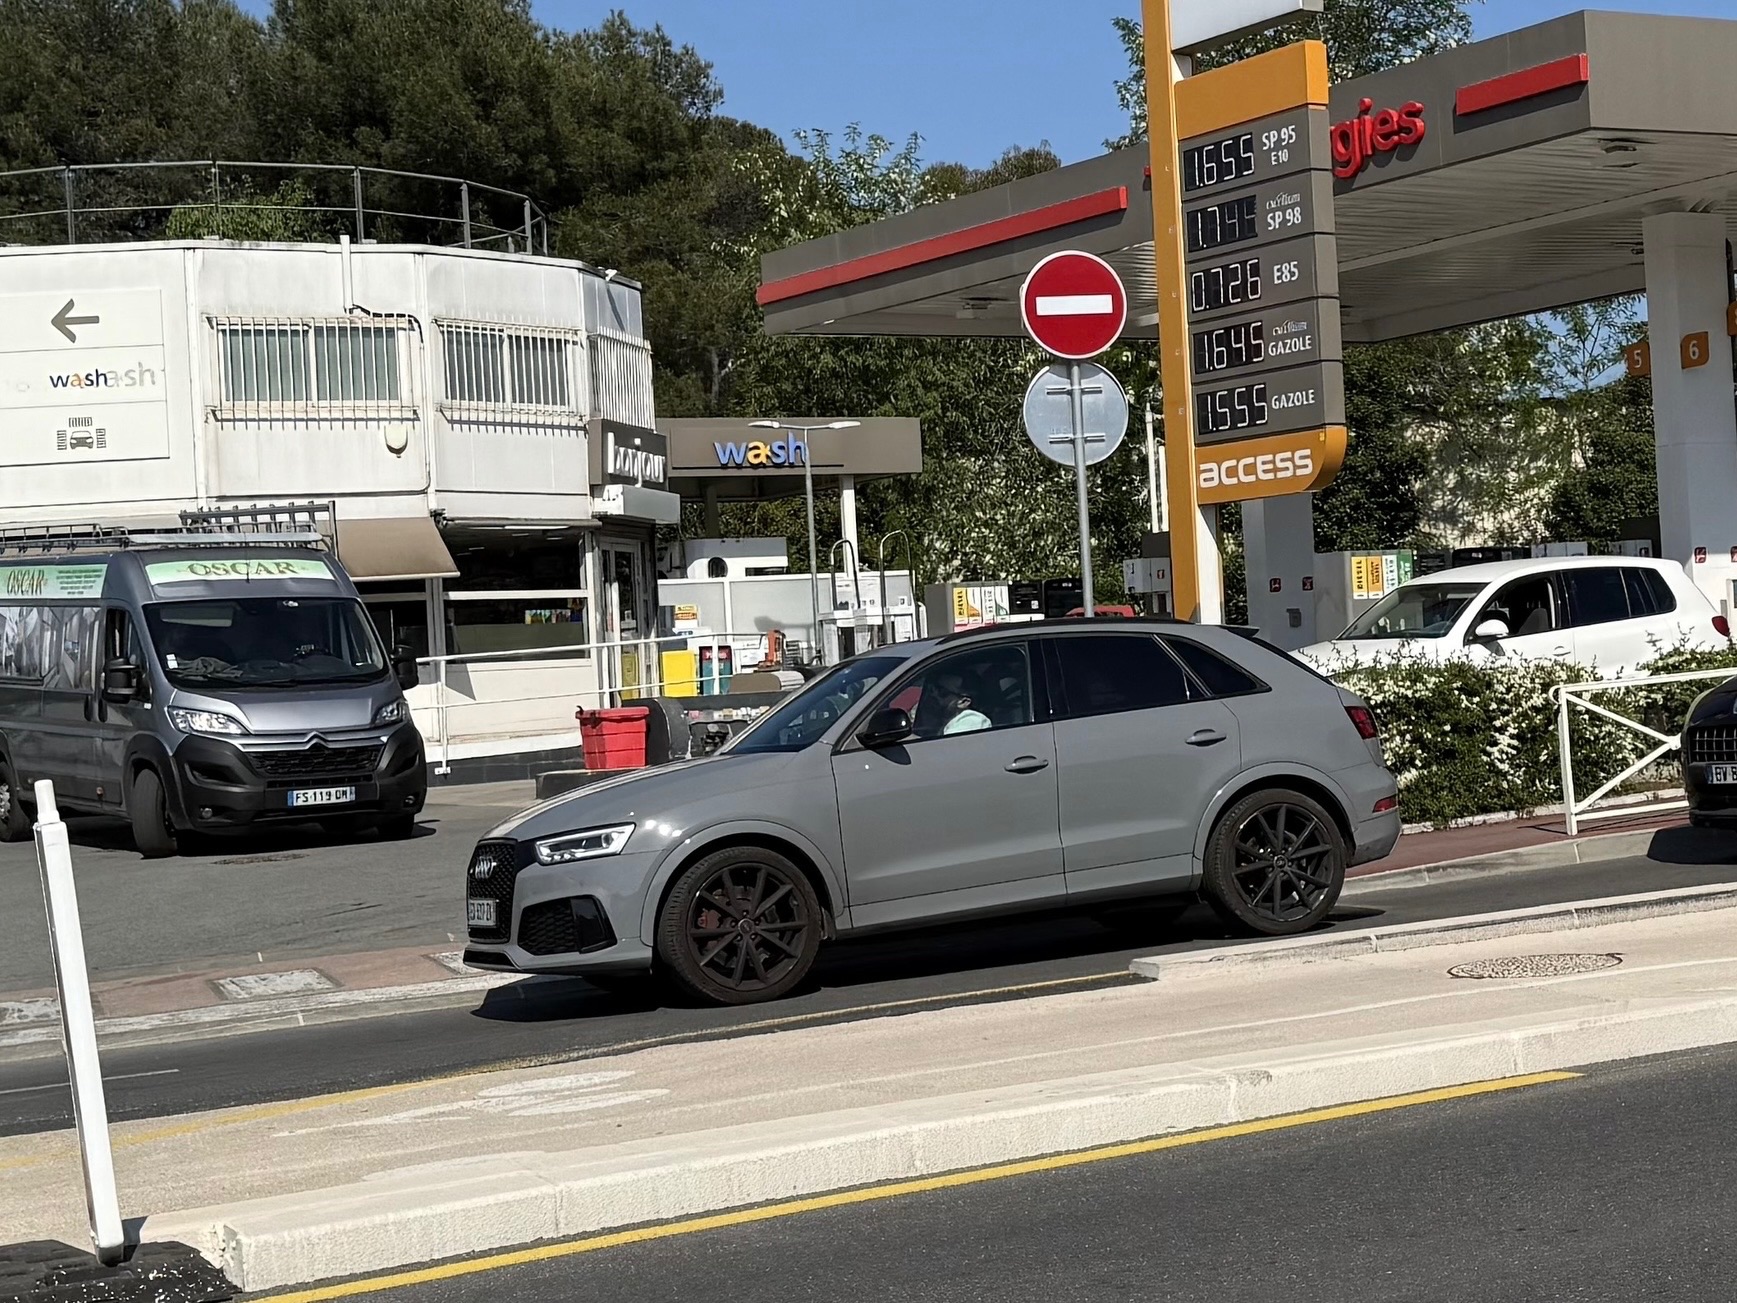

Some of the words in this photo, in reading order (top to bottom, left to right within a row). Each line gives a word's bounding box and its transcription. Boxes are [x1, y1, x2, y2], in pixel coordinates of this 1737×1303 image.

[1262, 130, 1278, 150] SP
[1281, 125, 1296, 146] 95
[1194, 134, 1255, 187] 1.655
[1271, 148, 1289, 165] E10
[1267, 211, 1283, 231] SP
[1285, 206, 1302, 227] 98
[1191, 259, 1261, 311] 0.726
[1273, 261, 1299, 285] E85
[1204, 321, 1265, 370] 1.645
[1268, 335, 1312, 357] GAZOLE
[1689, 340, 1699, 360] 6
[1633, 349, 1642, 368] 5
[1207, 384, 1268, 431] 1.555
[1271, 389, 1315, 410] GAZOLE
[713, 430, 807, 466] wash
[187, 561, 299, 577] OSCAR
